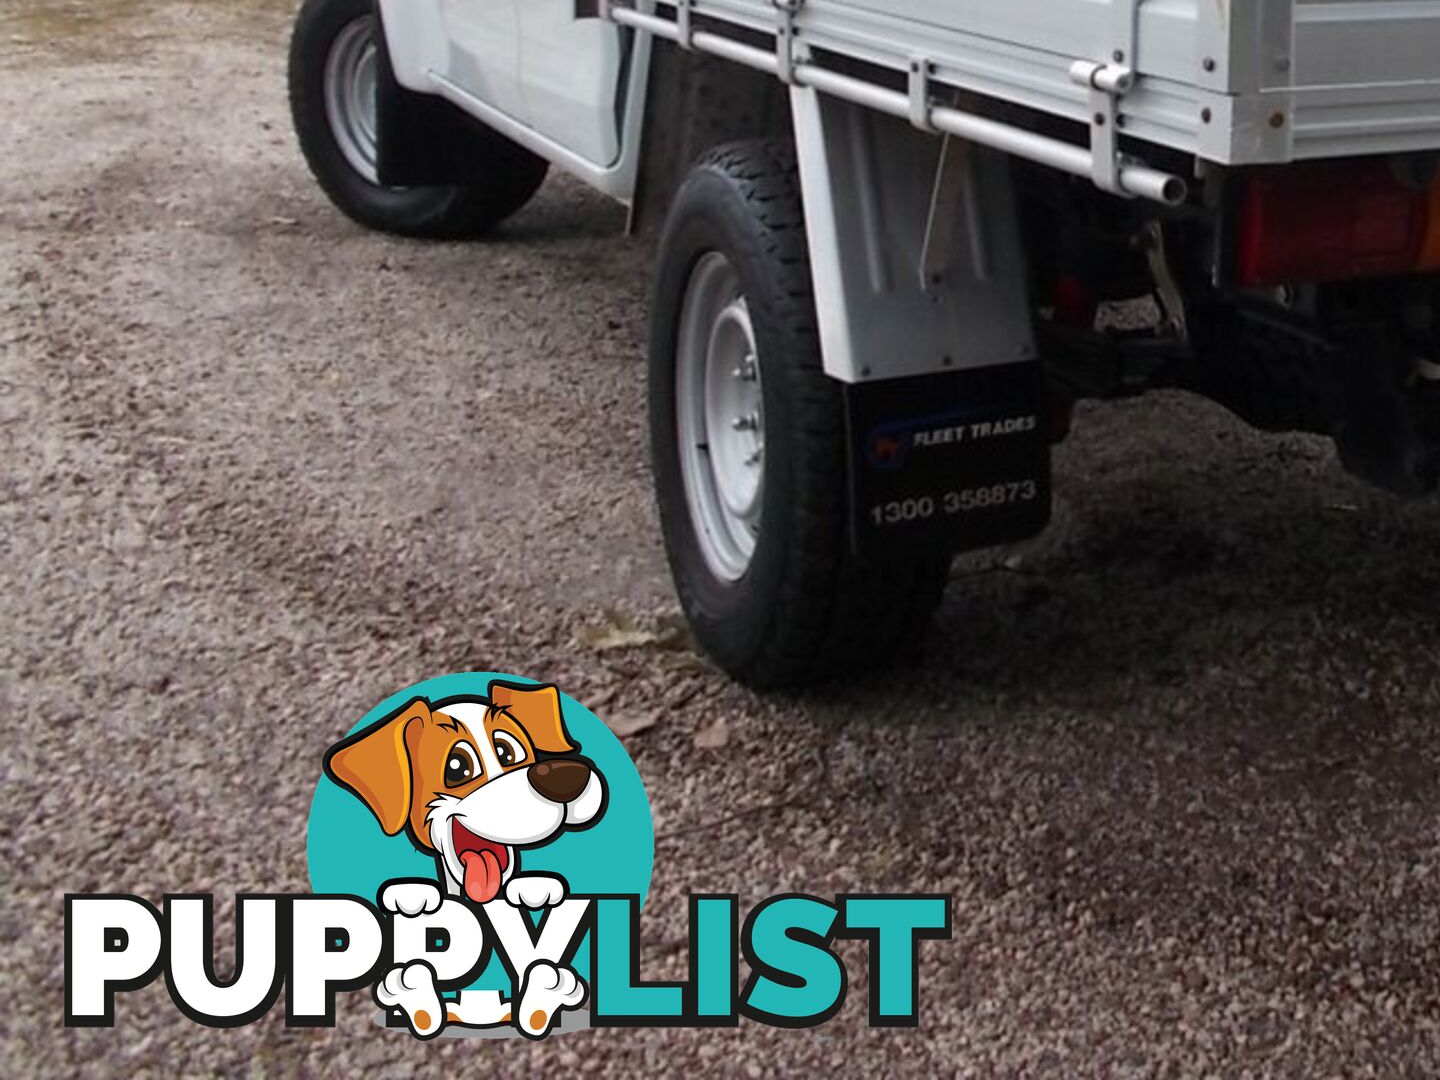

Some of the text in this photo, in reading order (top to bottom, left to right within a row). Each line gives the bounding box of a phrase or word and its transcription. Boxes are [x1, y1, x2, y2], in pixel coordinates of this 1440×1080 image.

[913, 415, 1037, 447] FLEET TRADES
[870, 480, 1037, 526] 1300 358873
